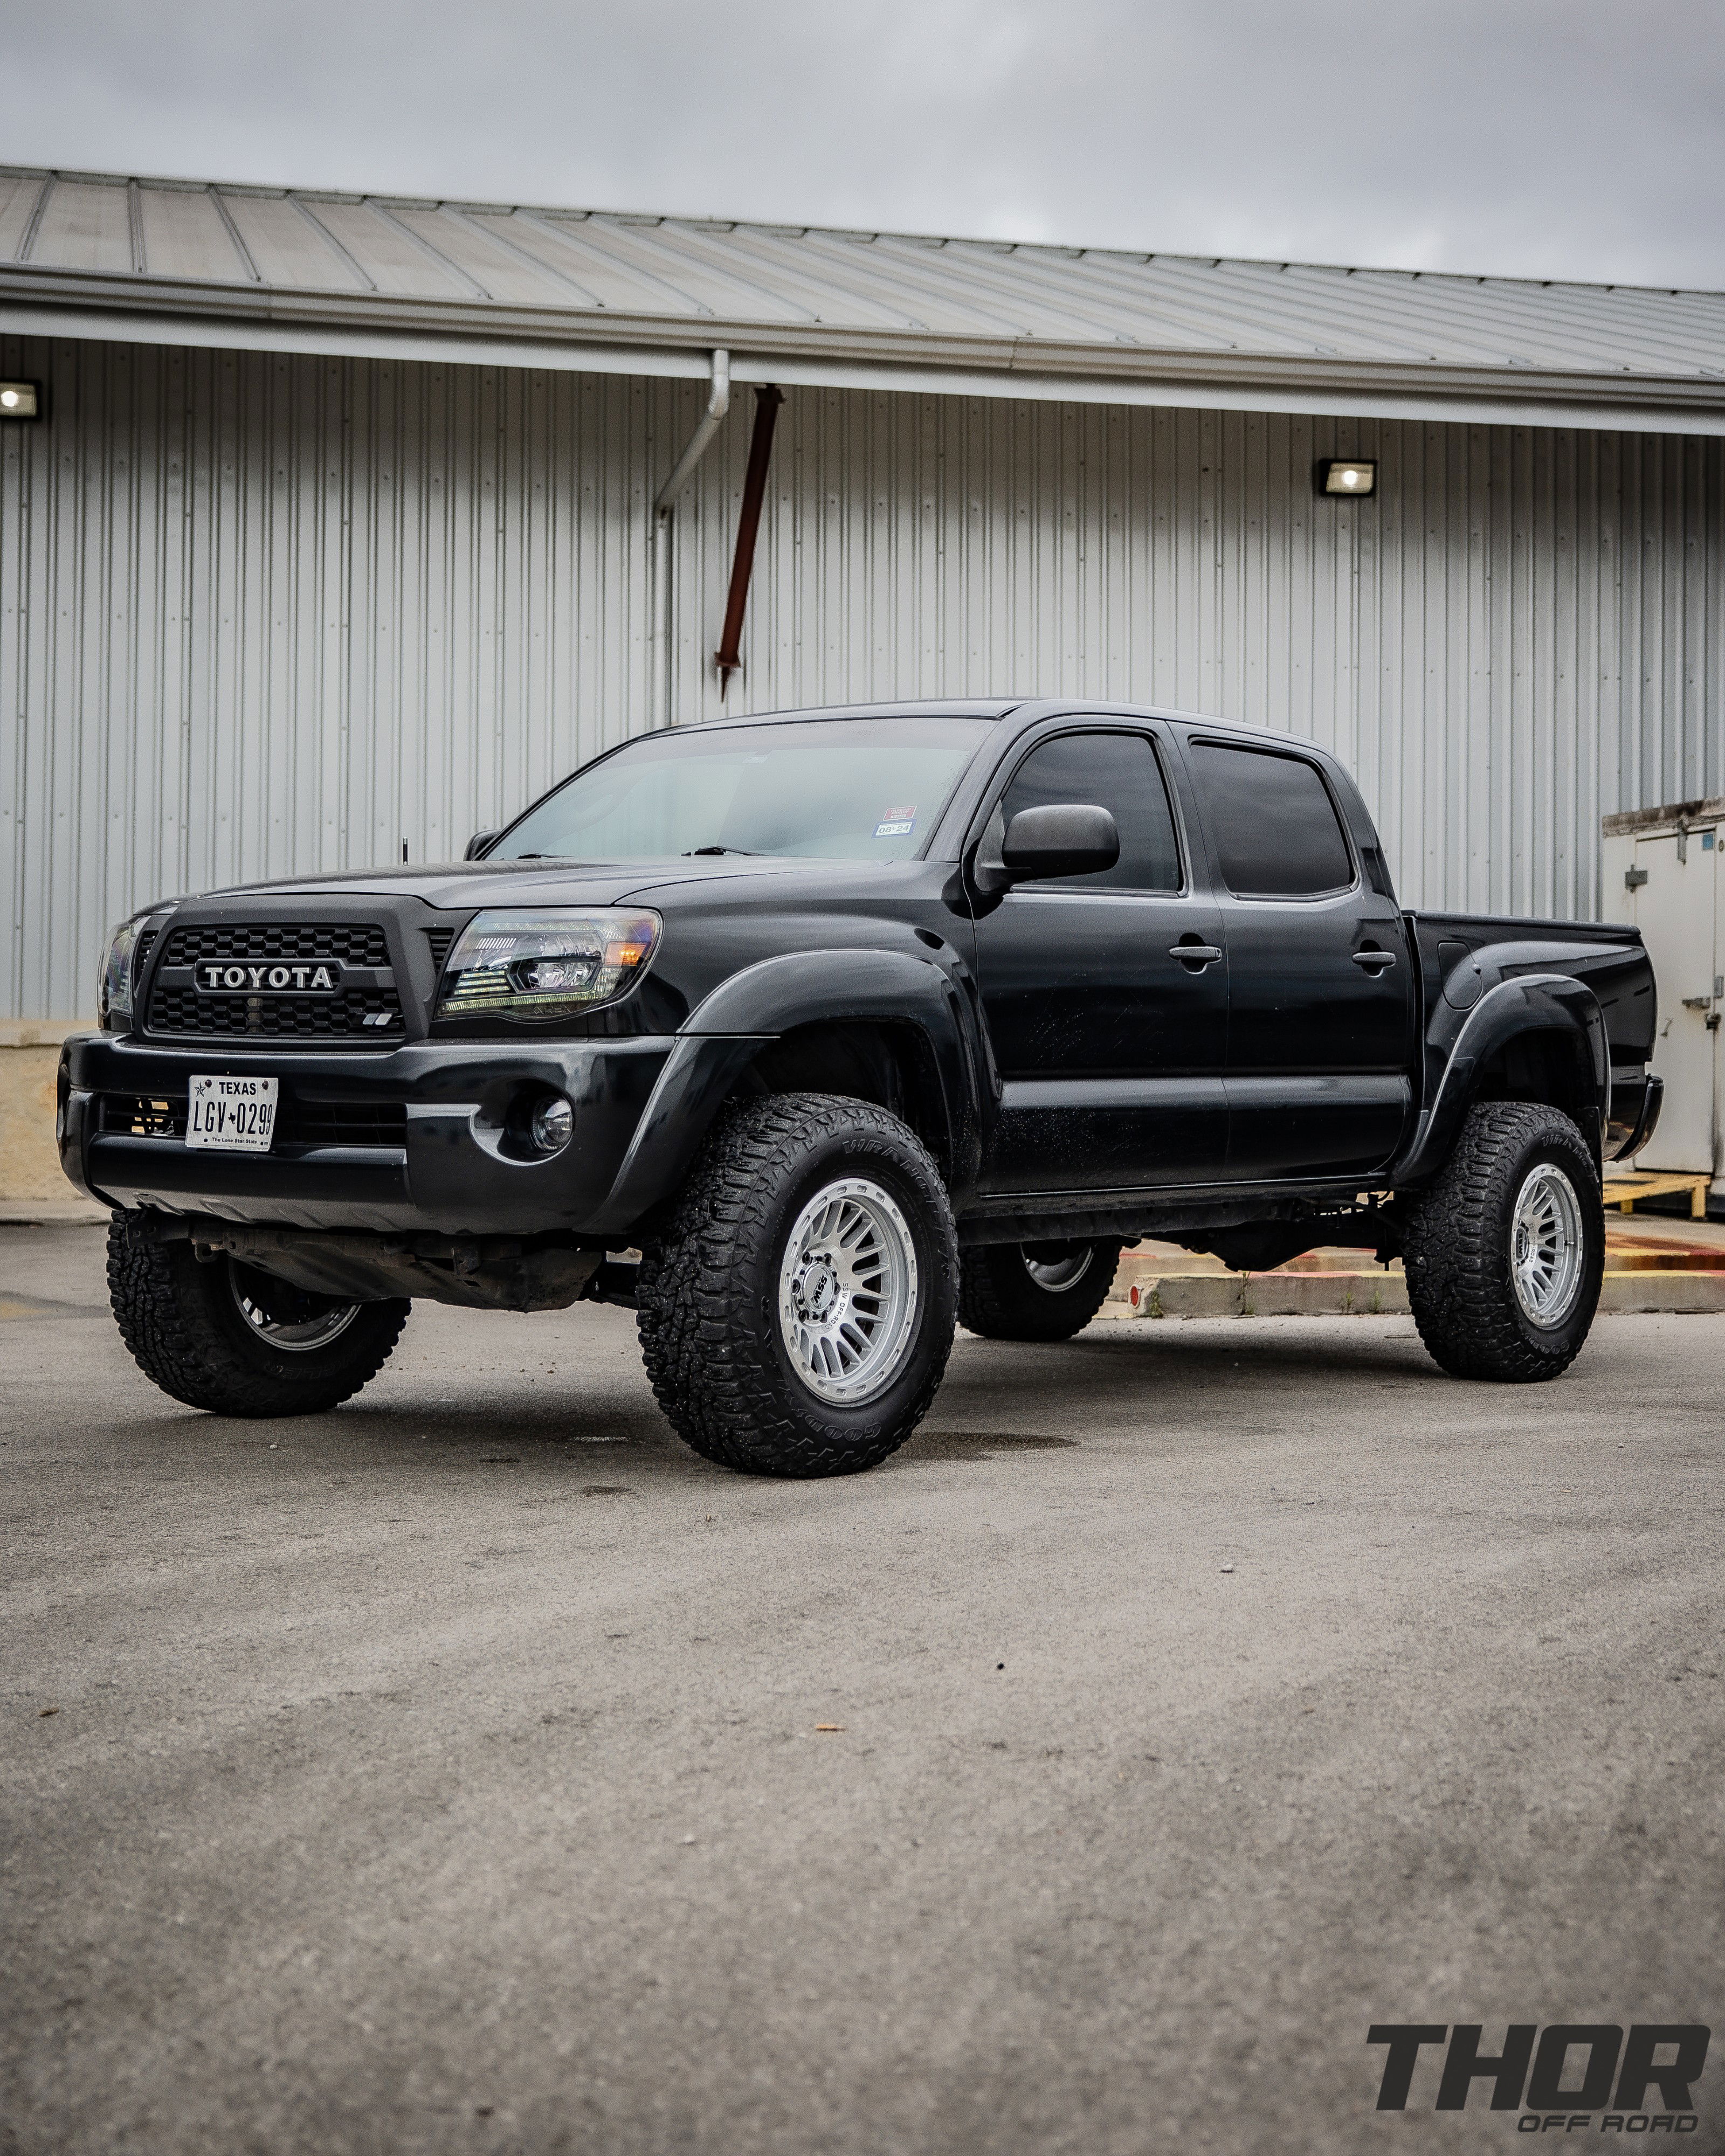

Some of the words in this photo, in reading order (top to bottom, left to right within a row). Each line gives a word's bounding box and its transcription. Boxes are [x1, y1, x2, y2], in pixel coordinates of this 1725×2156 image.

[205, 967, 333, 988] TOYOTA
[219, 1081, 257, 1095] TEXAS
[813, 1274, 828, 1304] SSW
